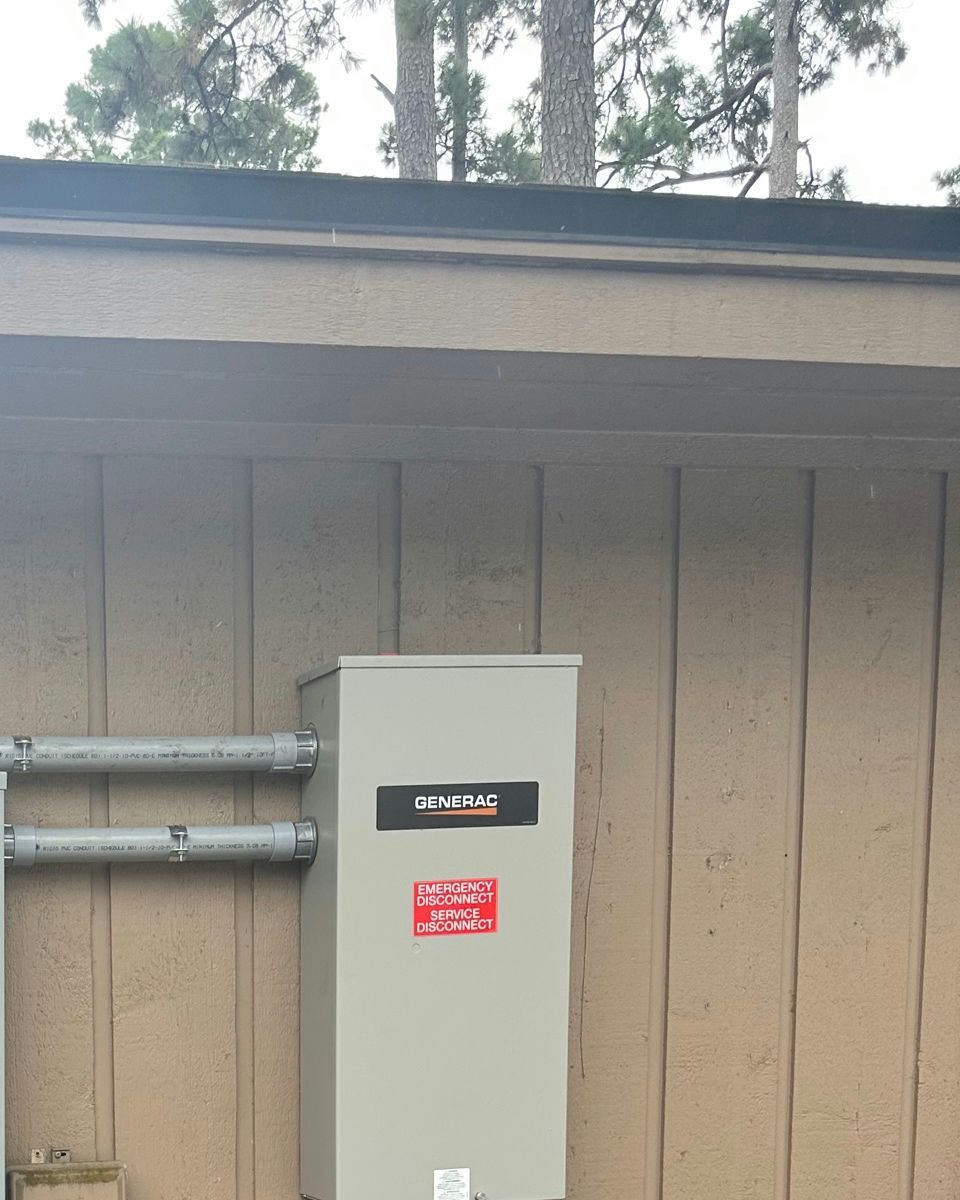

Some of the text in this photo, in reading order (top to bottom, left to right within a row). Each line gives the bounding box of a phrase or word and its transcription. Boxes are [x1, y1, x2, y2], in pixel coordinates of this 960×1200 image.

[414, 794, 498, 810] GENERAC
[418, 881, 493, 895] EMERGENCY
[416, 892, 494, 907] DISCONNECT
[430, 908, 480, 921] SERVICE
[416, 918, 494, 933] DISCONNECT
